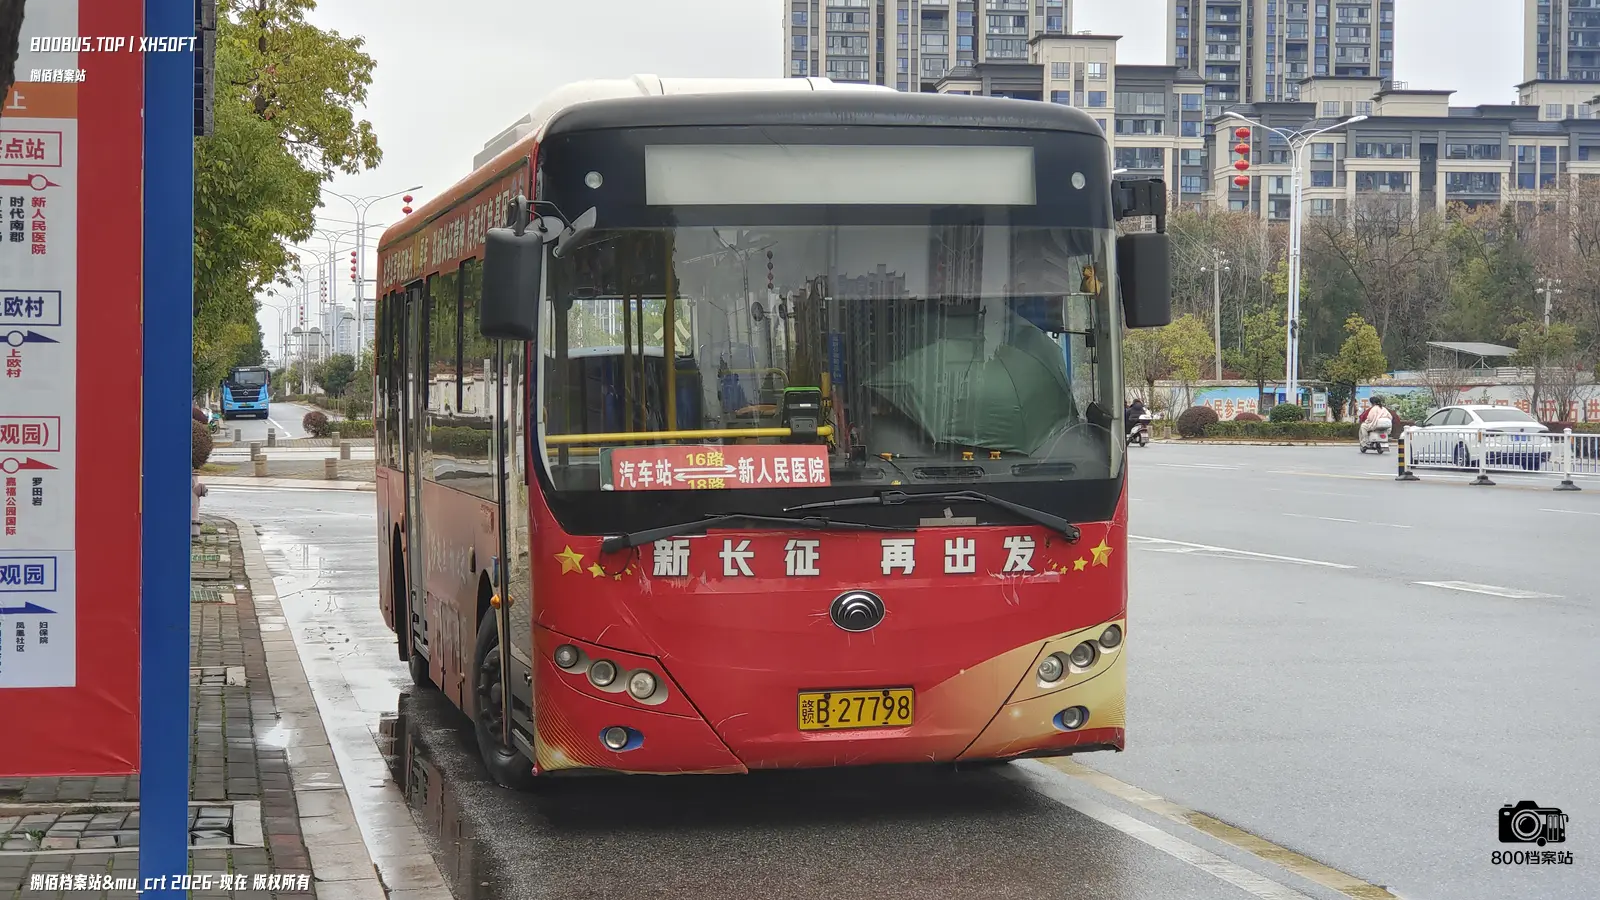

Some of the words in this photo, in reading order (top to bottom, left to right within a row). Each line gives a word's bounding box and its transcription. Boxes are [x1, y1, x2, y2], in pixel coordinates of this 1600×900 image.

[6, 91, 27, 109] 上
[0, 138, 45, 160] 点站
[10, 196, 24, 242] 时代南郡
[32, 197, 46, 255] 新人民医院
[0, 296, 44, 318] 欧村
[7, 348, 22, 378] 上欧村
[619, 458, 673, 488] 汽车站
[737, 456, 826, 484] 新人民医院
[686, 451, 725, 467] 16路
[32, 477, 43, 507] 罗田岩
[687, 477, 726, 489] 18路
[653, 538, 820, 577] 新长征
[880, 535, 1036, 576] 再出发
[16, 621, 25, 652] 凤凰社区
[39, 621, 49, 644] 妇保院
